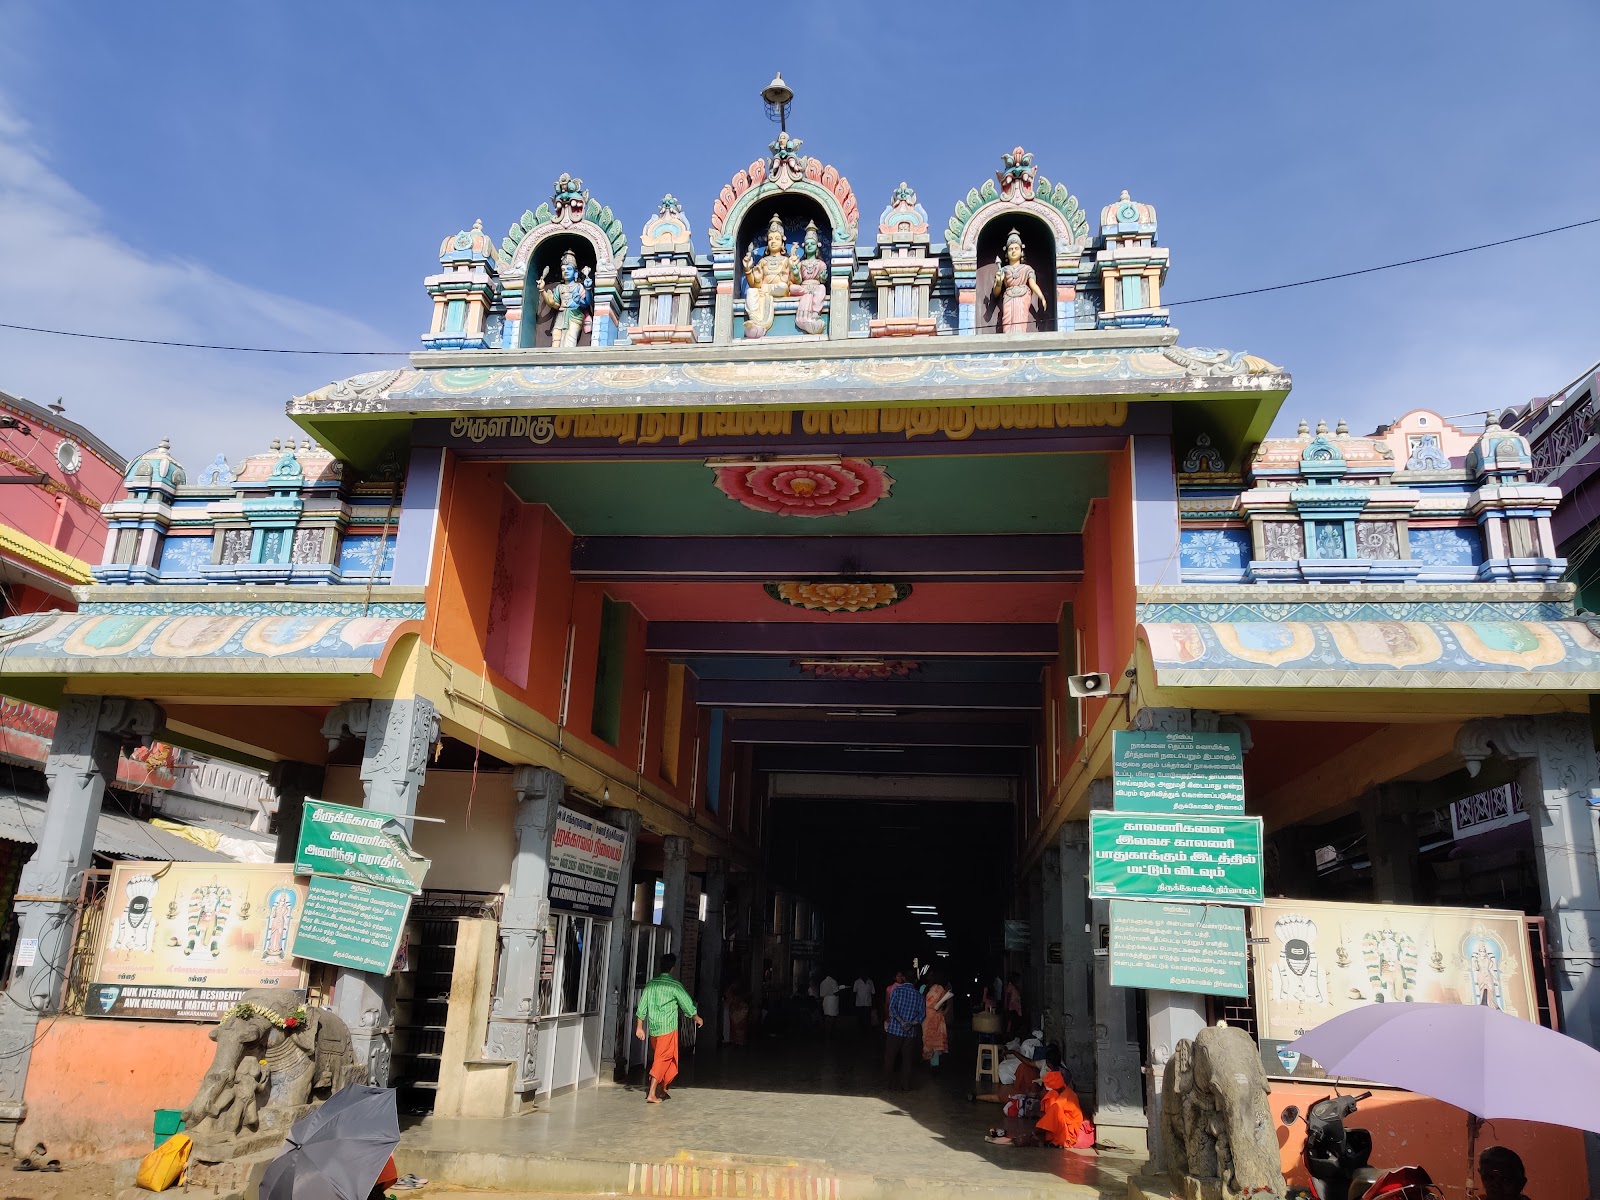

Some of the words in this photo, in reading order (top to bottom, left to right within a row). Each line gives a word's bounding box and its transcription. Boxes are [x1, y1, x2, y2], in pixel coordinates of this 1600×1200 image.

[1187, 782, 1221, 790] கிடையாது
[1215, 803, 1243, 811] நிர்வாகம்
[311, 808, 386, 830] திருக்கோவி
[1123, 822, 1225, 834] காலணிகளை
[329, 830, 394, 847] காலணிக
[1116, 835, 1171, 846] இலவச
[1174, 838, 1235, 848] காலணி
[305, 844, 356, 864] அணிந்து
[1096, 850, 1187, 862] பாதுகாக்கும்
[1190, 852, 1256, 865] இடத்தில்
[1127, 864, 1171, 876] மட்டும்
[1174, 865, 1225, 879] விடவும்
[1157, 883, 1214, 893] திருக்கோவில்
[1215, 884, 1257, 895] நிர்வாகம்
[1202, 948, 1245, 957] திருக்கோவில்
[1169, 977, 1212, 986] திருக்கோவில்
[1214, 979, 1243, 988] நிர்வாகம்
[121, 987, 137, 998] AVK
[137, 988, 198, 999] INTERNATIONAL
[200, 990, 246, 1000] RESIDENTI
[124, 999, 140, 1008] AVK
[141, 1000, 183, 1010] MEMORIAL
[184, 1001, 215, 1011] MATRIC
